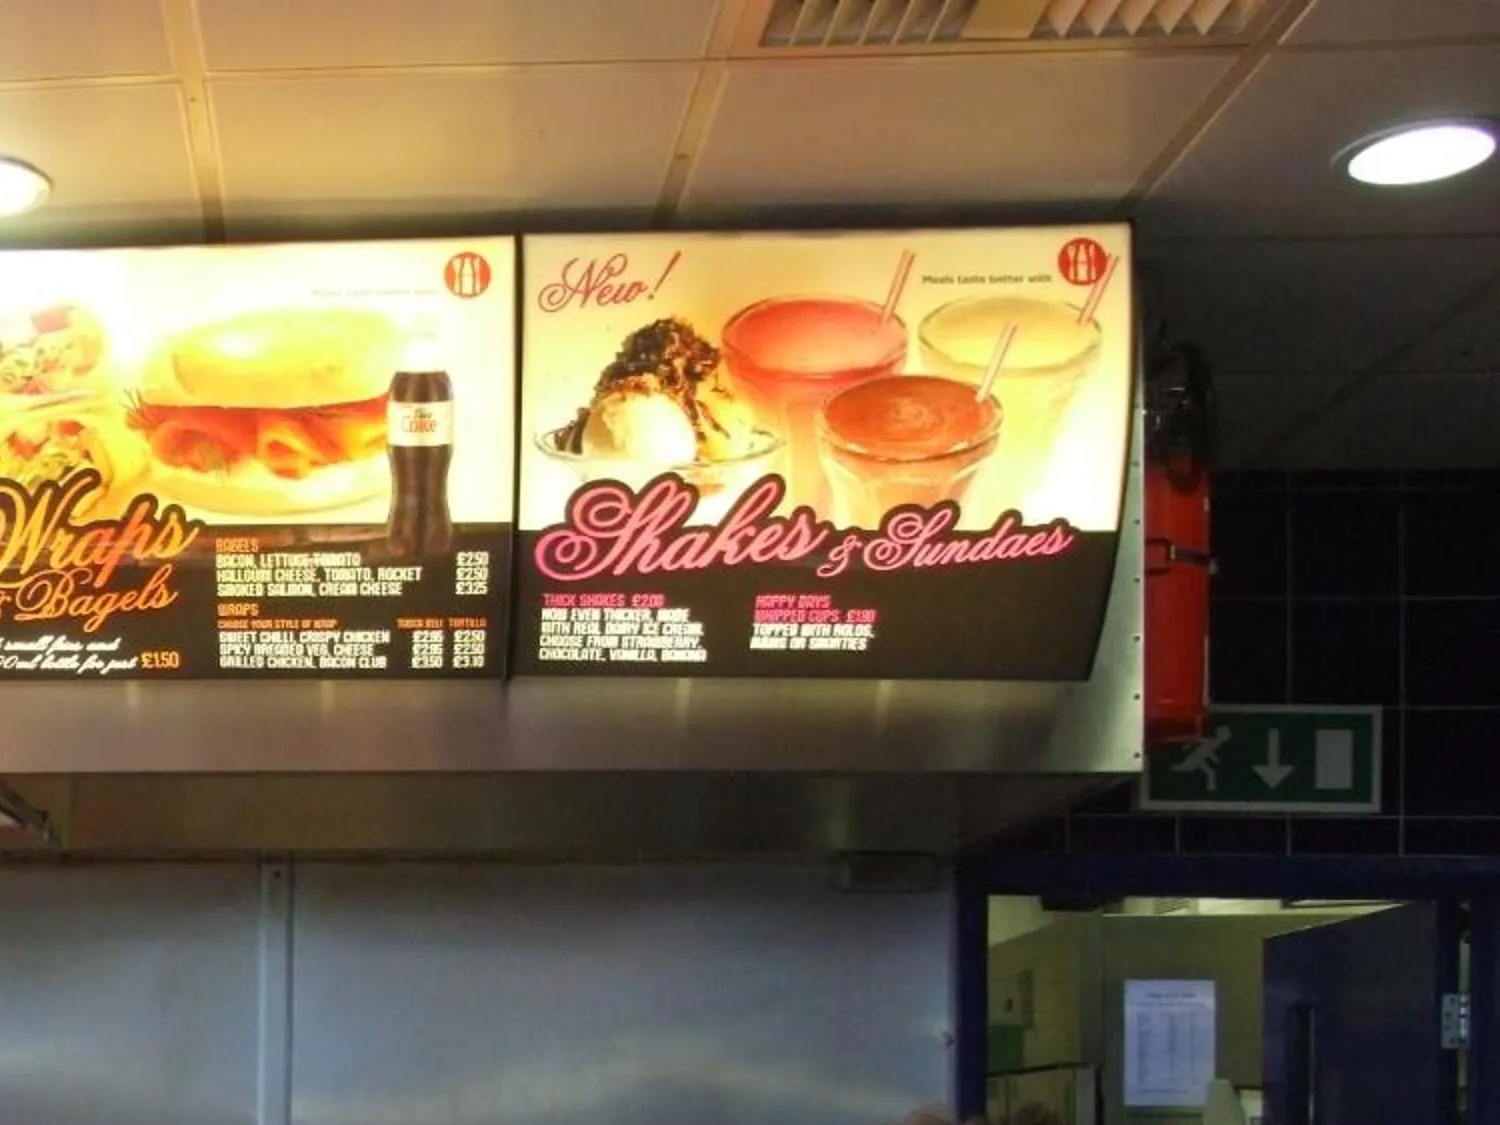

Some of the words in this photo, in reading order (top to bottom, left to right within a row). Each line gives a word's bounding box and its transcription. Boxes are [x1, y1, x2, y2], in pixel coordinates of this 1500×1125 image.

[538, 250, 682, 313] New!
[922, 275, 955, 285] Meals
[957, 275, 986, 285] taste
[988, 274, 1024, 284] better
[1028, 274, 1053, 284] with
[534, 478, 830, 581] Shakes
[817, 535, 862, 577] &
[863, 508, 1076, 571] Sundaes
[377, 566, 422, 581] ROCKET
[217, 583, 265, 597] SMOKED
[360, 582, 403, 596] CHEESE
[14, 564, 178, 633] Bagels
[579, 594, 626, 607] SHAKES
[343, 630, 391, 643] CHICKEN
[753, 623, 799, 636] TOPPED
[800, 623, 832, 636] WITH
[333, 643, 374, 656] CHEESE
